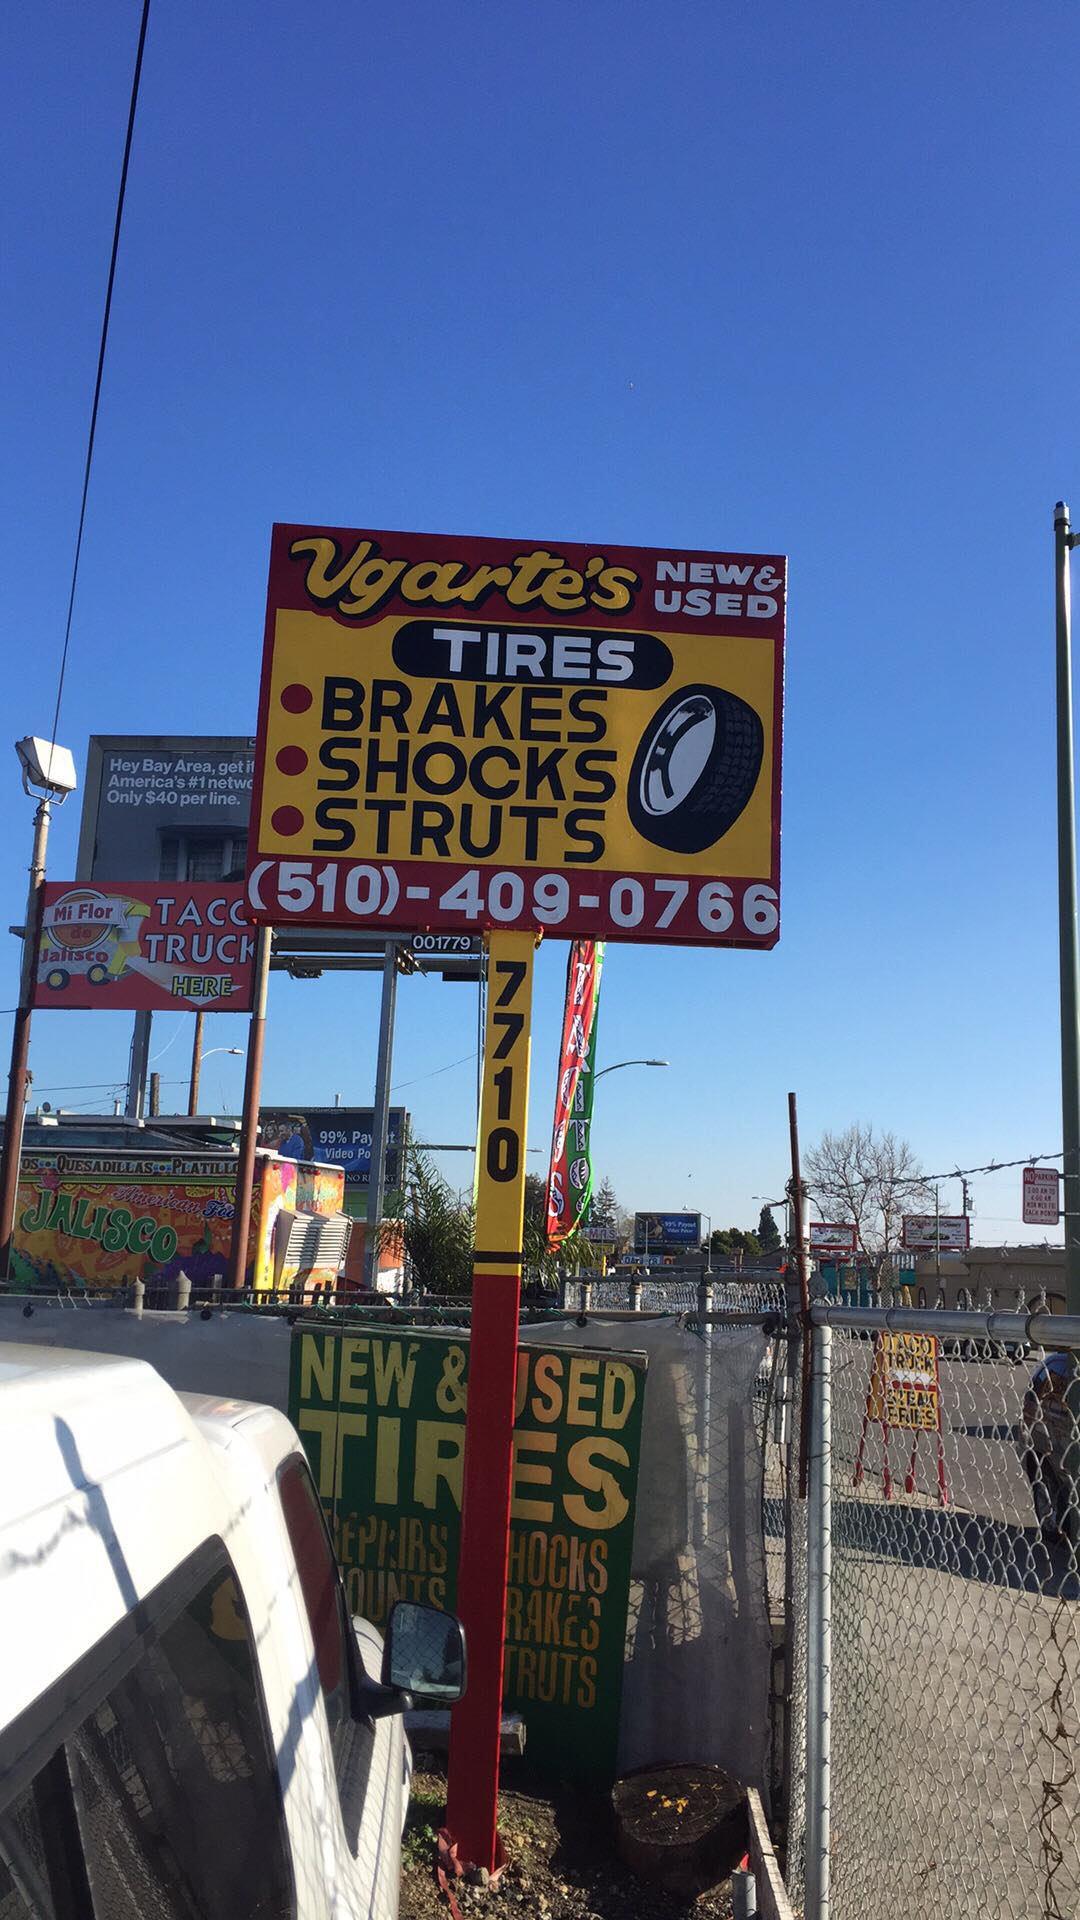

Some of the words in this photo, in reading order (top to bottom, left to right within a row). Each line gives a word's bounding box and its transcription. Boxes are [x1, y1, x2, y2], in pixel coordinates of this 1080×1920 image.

[291, 537, 639, 614] Ugarte's
[654, 590, 778, 619] USED
[433, 628, 636, 681] TIRES
[322, 676, 608, 742] BRAKES
[110, 759, 140, 774] Hey
[142, 759, 172, 774] Bay
[174, 760, 215, 775] Area,
[218, 761, 244, 775] get
[317, 737, 617, 802] SHOCKS
[108, 774, 186, 788] America's
[188, 776, 206, 788] #1
[107, 790, 142, 806] Only
[145, 790, 178, 805] $40
[180, 793, 207, 807] per
[209, 792, 240, 805] line.
[312, 797, 606, 863] STRUTS
[54, 905, 73, 921] Mi
[78, 903, 113, 920] Flor
[71, 924, 92, 938] de
[145, 933, 255, 965] TRUCK
[412, 935, 472, 950] 001779
[41, 948, 109, 963] Jalisco
[172, 975, 234, 997] HERE
[486, 961, 527, 1183] 7710
[319, 1130, 347, 1144] 99%
[21, 1158, 40, 1171] OS
[57, 1154, 154, 1175] QUESADILLAS
[173, 1157, 241, 1175] PLATILLO
[325, 1148, 354, 1159] Video
[1024, 1170, 1034, 1182] NO
[22, 1189, 178, 1263] JALISCO
[885, 1333, 932, 1354] TACO
[886, 1352, 933, 1371] TRUCK
[301, 1334, 421, 1408] NEW
[436, 1345, 468, 1414] &
[509, 1530, 609, 1594] HOCKS
[506, 1588, 601, 1652] RAKES
[502, 1645, 597, 1709] TRUTS
